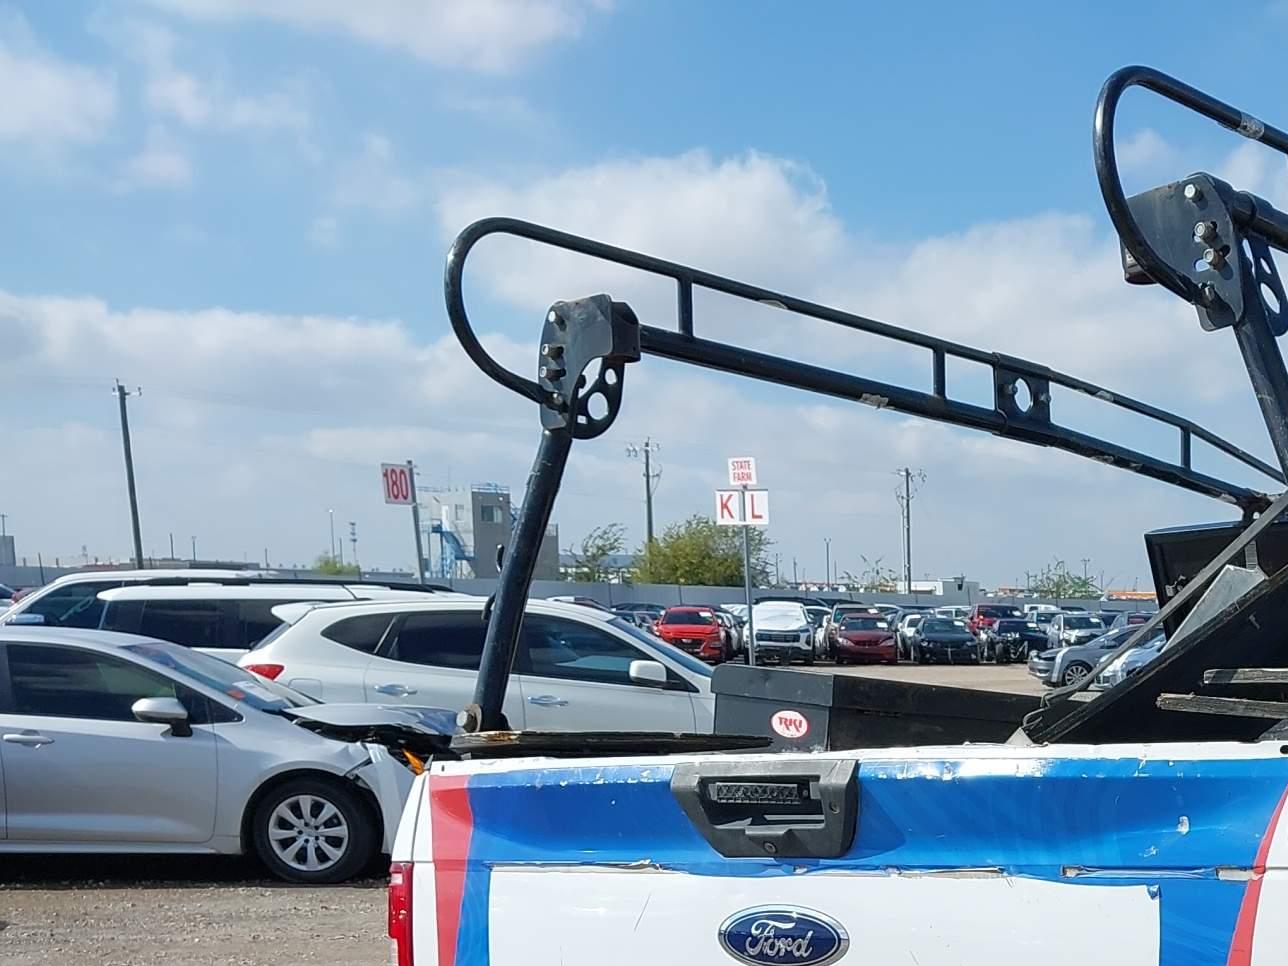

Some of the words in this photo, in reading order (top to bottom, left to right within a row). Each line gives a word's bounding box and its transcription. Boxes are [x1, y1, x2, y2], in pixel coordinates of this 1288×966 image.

[731, 460, 751, 471] STATE
[732, 471, 752, 482] FARM
[383, 468, 409, 500] 180
[720, 494, 735, 519] K
[750, 493, 763, 519] L
[744, 919, 814, 958] Ford
